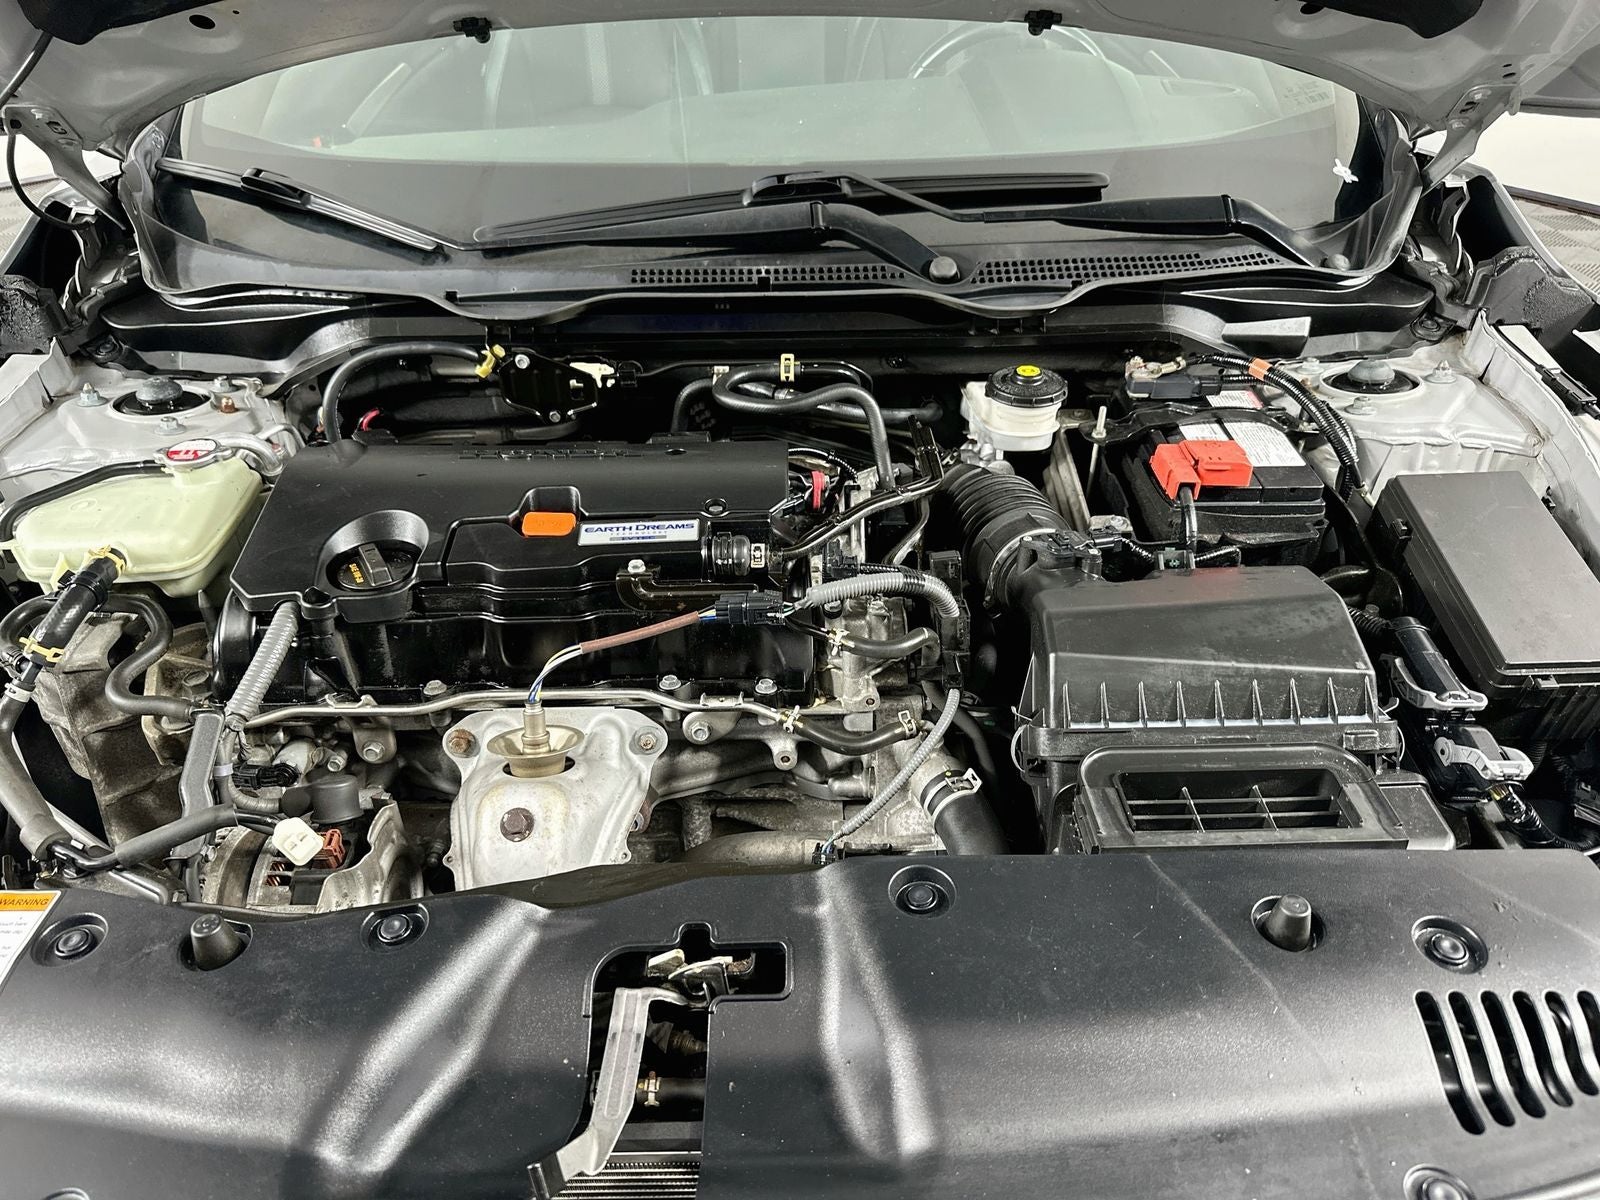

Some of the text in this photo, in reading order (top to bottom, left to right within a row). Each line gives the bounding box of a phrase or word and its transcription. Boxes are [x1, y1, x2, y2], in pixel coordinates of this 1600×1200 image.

[584, 523, 695, 533] EARTH DREAMS
[0, 898, 49, 906] WARNING
